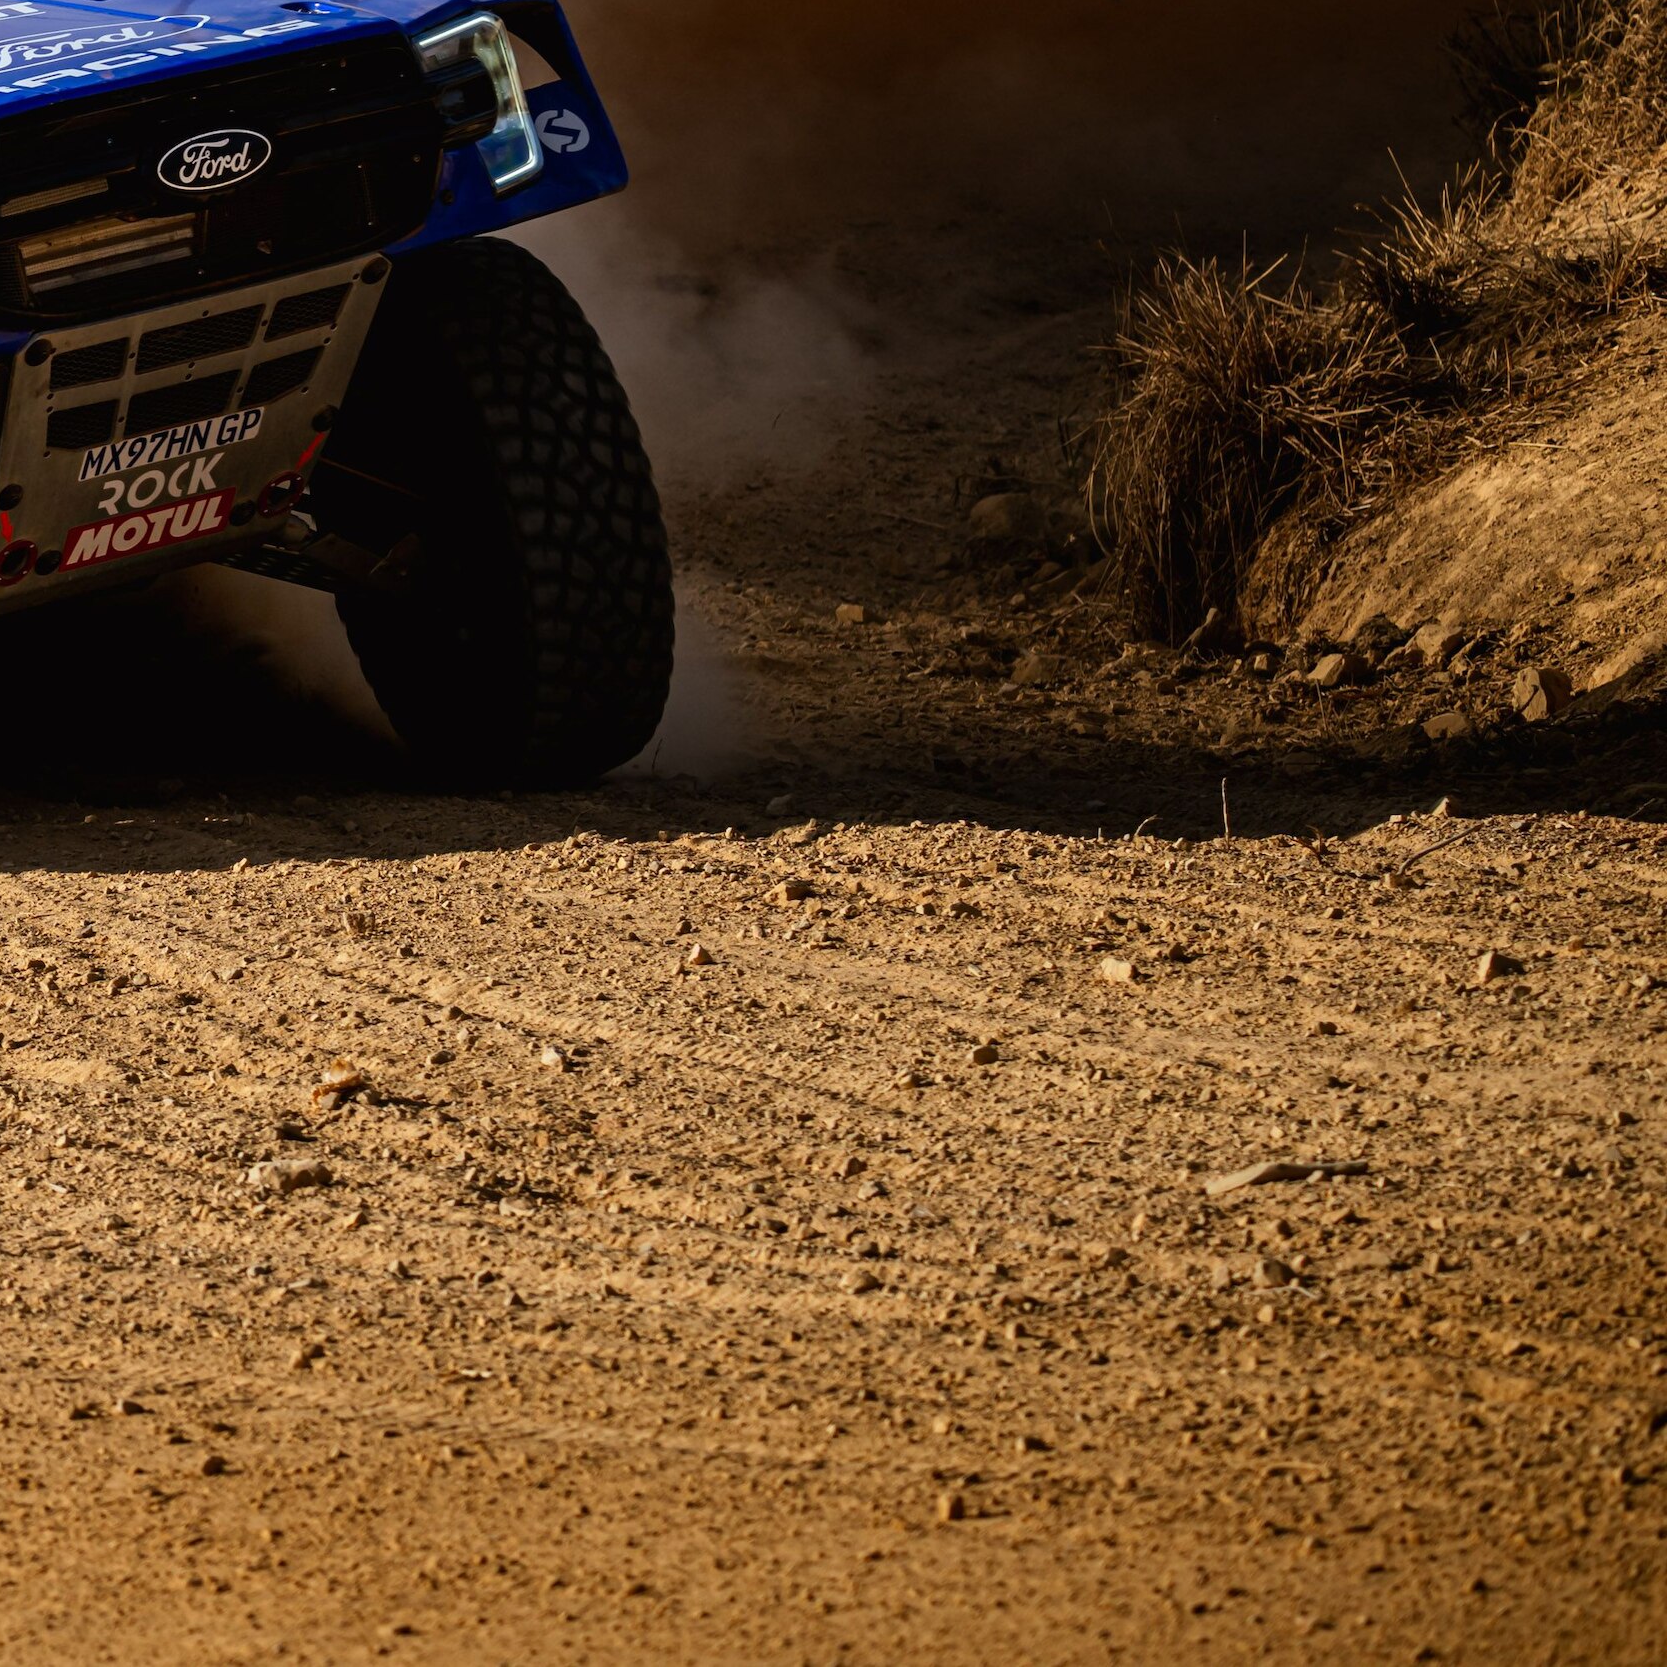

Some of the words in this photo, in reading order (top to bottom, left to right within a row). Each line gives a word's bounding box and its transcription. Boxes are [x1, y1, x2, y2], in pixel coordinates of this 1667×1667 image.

[179, 138, 252, 183] Ford
[81, 420, 212, 480] MX97HN
[216, 409, 262, 445] GP
[97, 452, 225, 515] ROCK
[66, 495, 223, 565] MOTUL
